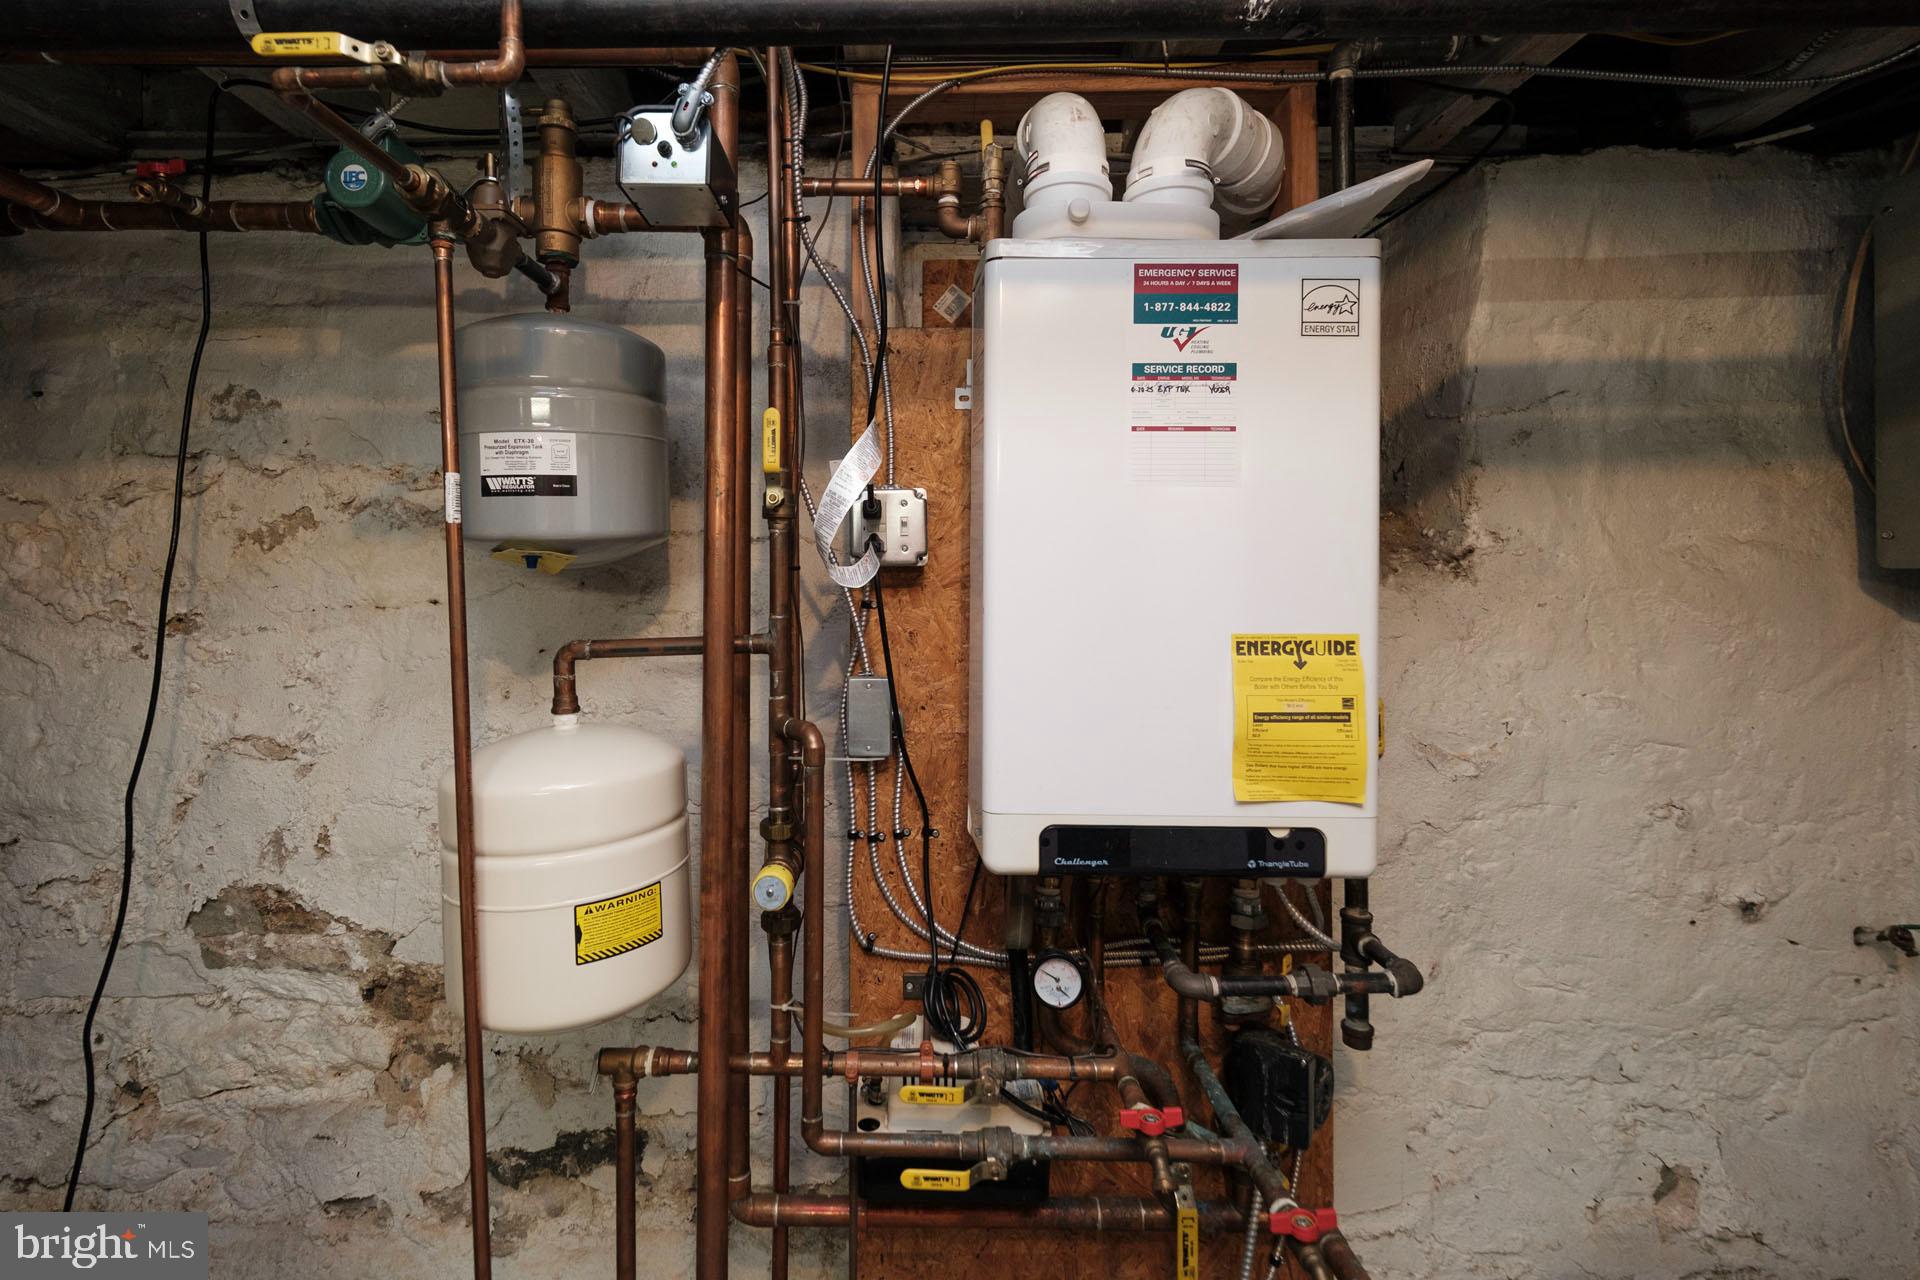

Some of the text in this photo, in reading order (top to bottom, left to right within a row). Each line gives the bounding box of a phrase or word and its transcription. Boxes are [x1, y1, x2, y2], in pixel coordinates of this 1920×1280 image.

[1138, 268, 1237, 278] EMERGENCY SERVICE
[1143, 302, 1231, 312] 1-877-844-4822
[1304, 325, 1356, 334] ENERGY STAR
[1143, 365, 1225, 374] SERVICE RECORD
[500, 477, 535, 485] WATTS
[1236, 640, 1356, 657] ENERGYGUIDE
[1054, 857, 1110, 868] Challenger
[1258, 860, 1310, 869] TriangleTube
[594, 887, 657, 913] WARNING:
